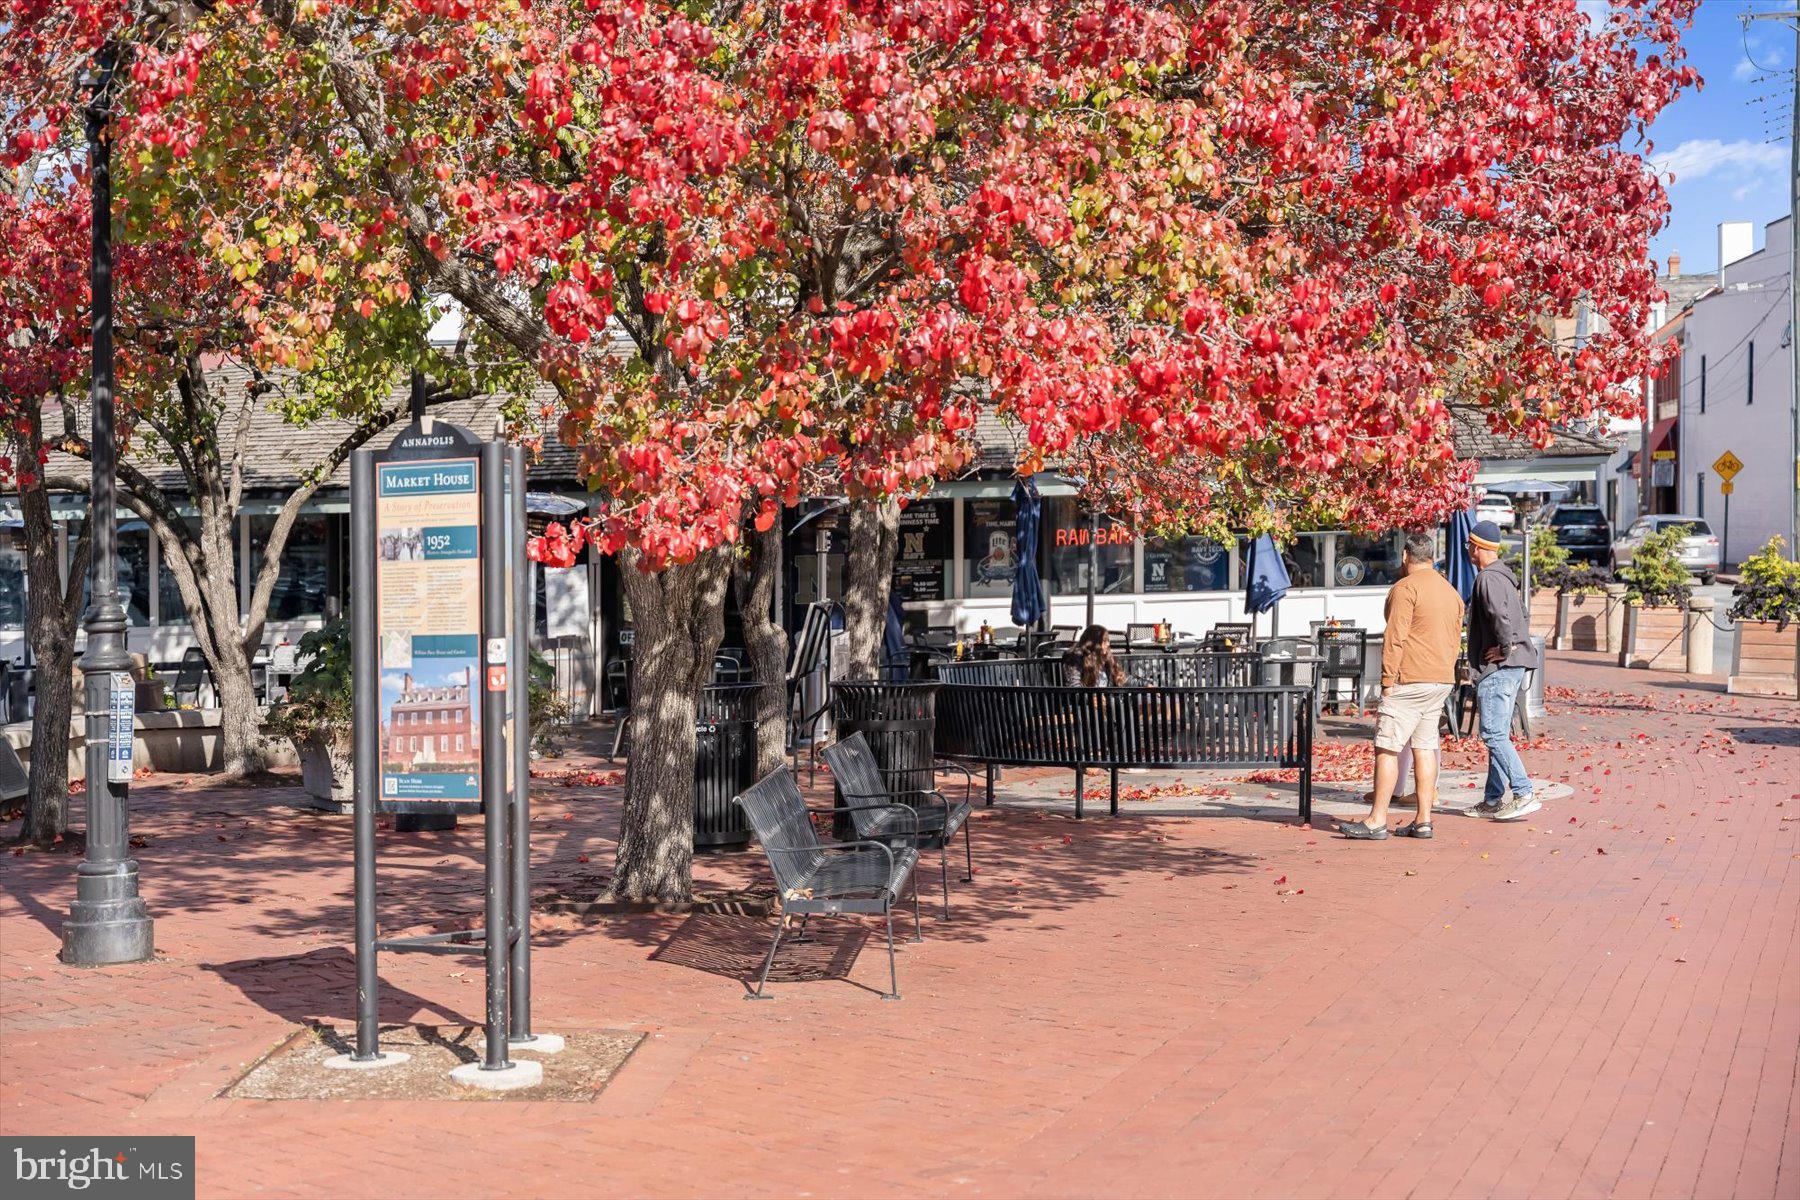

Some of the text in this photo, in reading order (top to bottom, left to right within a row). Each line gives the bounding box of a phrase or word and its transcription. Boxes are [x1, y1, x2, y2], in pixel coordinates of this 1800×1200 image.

[402, 436, 454, 447] ANNAPOLIS
[386, 473, 470, 488] MARKET HOUSE
[427, 535, 450, 550] 1952
[903, 532, 925, 553] N
[1152, 563, 1165, 577] N
